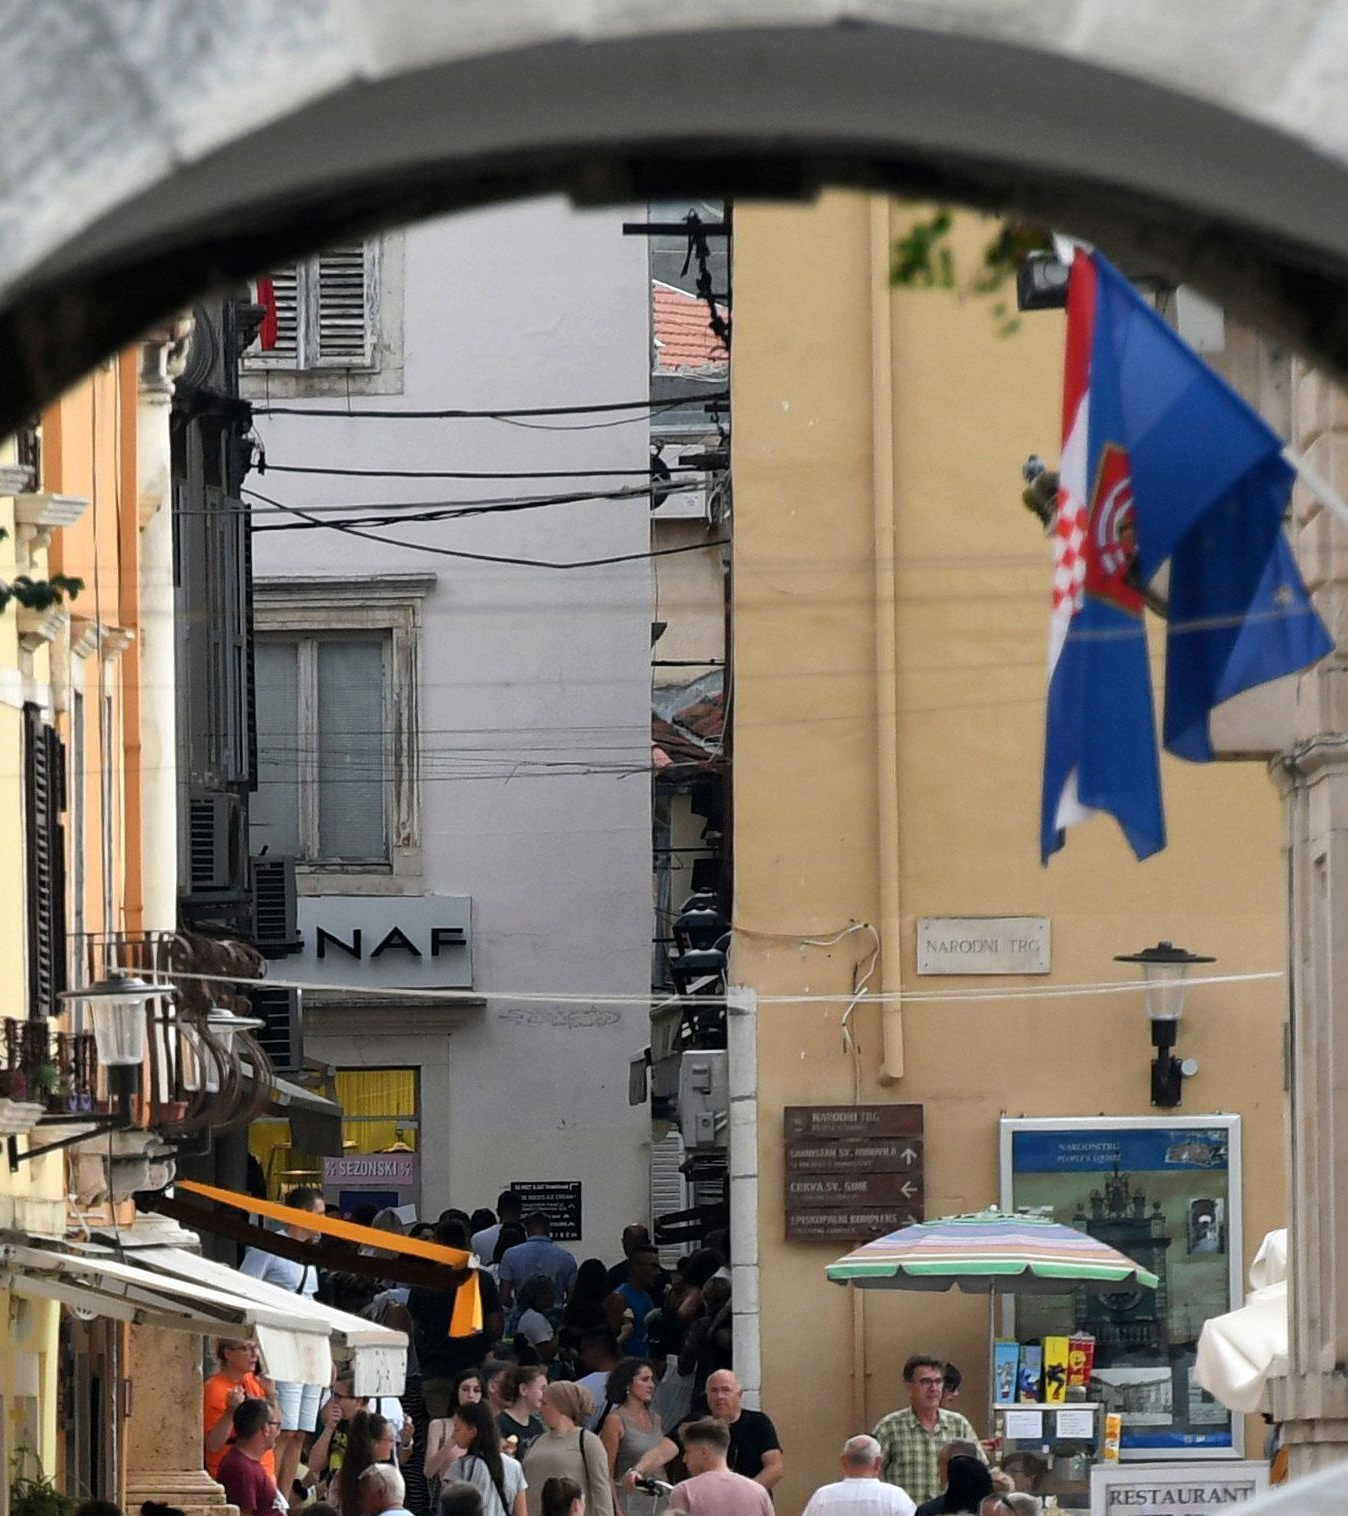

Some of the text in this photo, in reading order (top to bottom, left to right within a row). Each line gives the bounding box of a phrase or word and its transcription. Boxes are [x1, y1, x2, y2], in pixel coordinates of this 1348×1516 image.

[926, 939, 1040, 953] NARODNI TRG
[811, 1112, 880, 1123] NARODNI TRG
[339, 1160, 398, 1176] SEZONSKI
[790, 1182, 824, 1192] CRKVA
[1110, 1487, 1252, 1506] RESTAURANT
